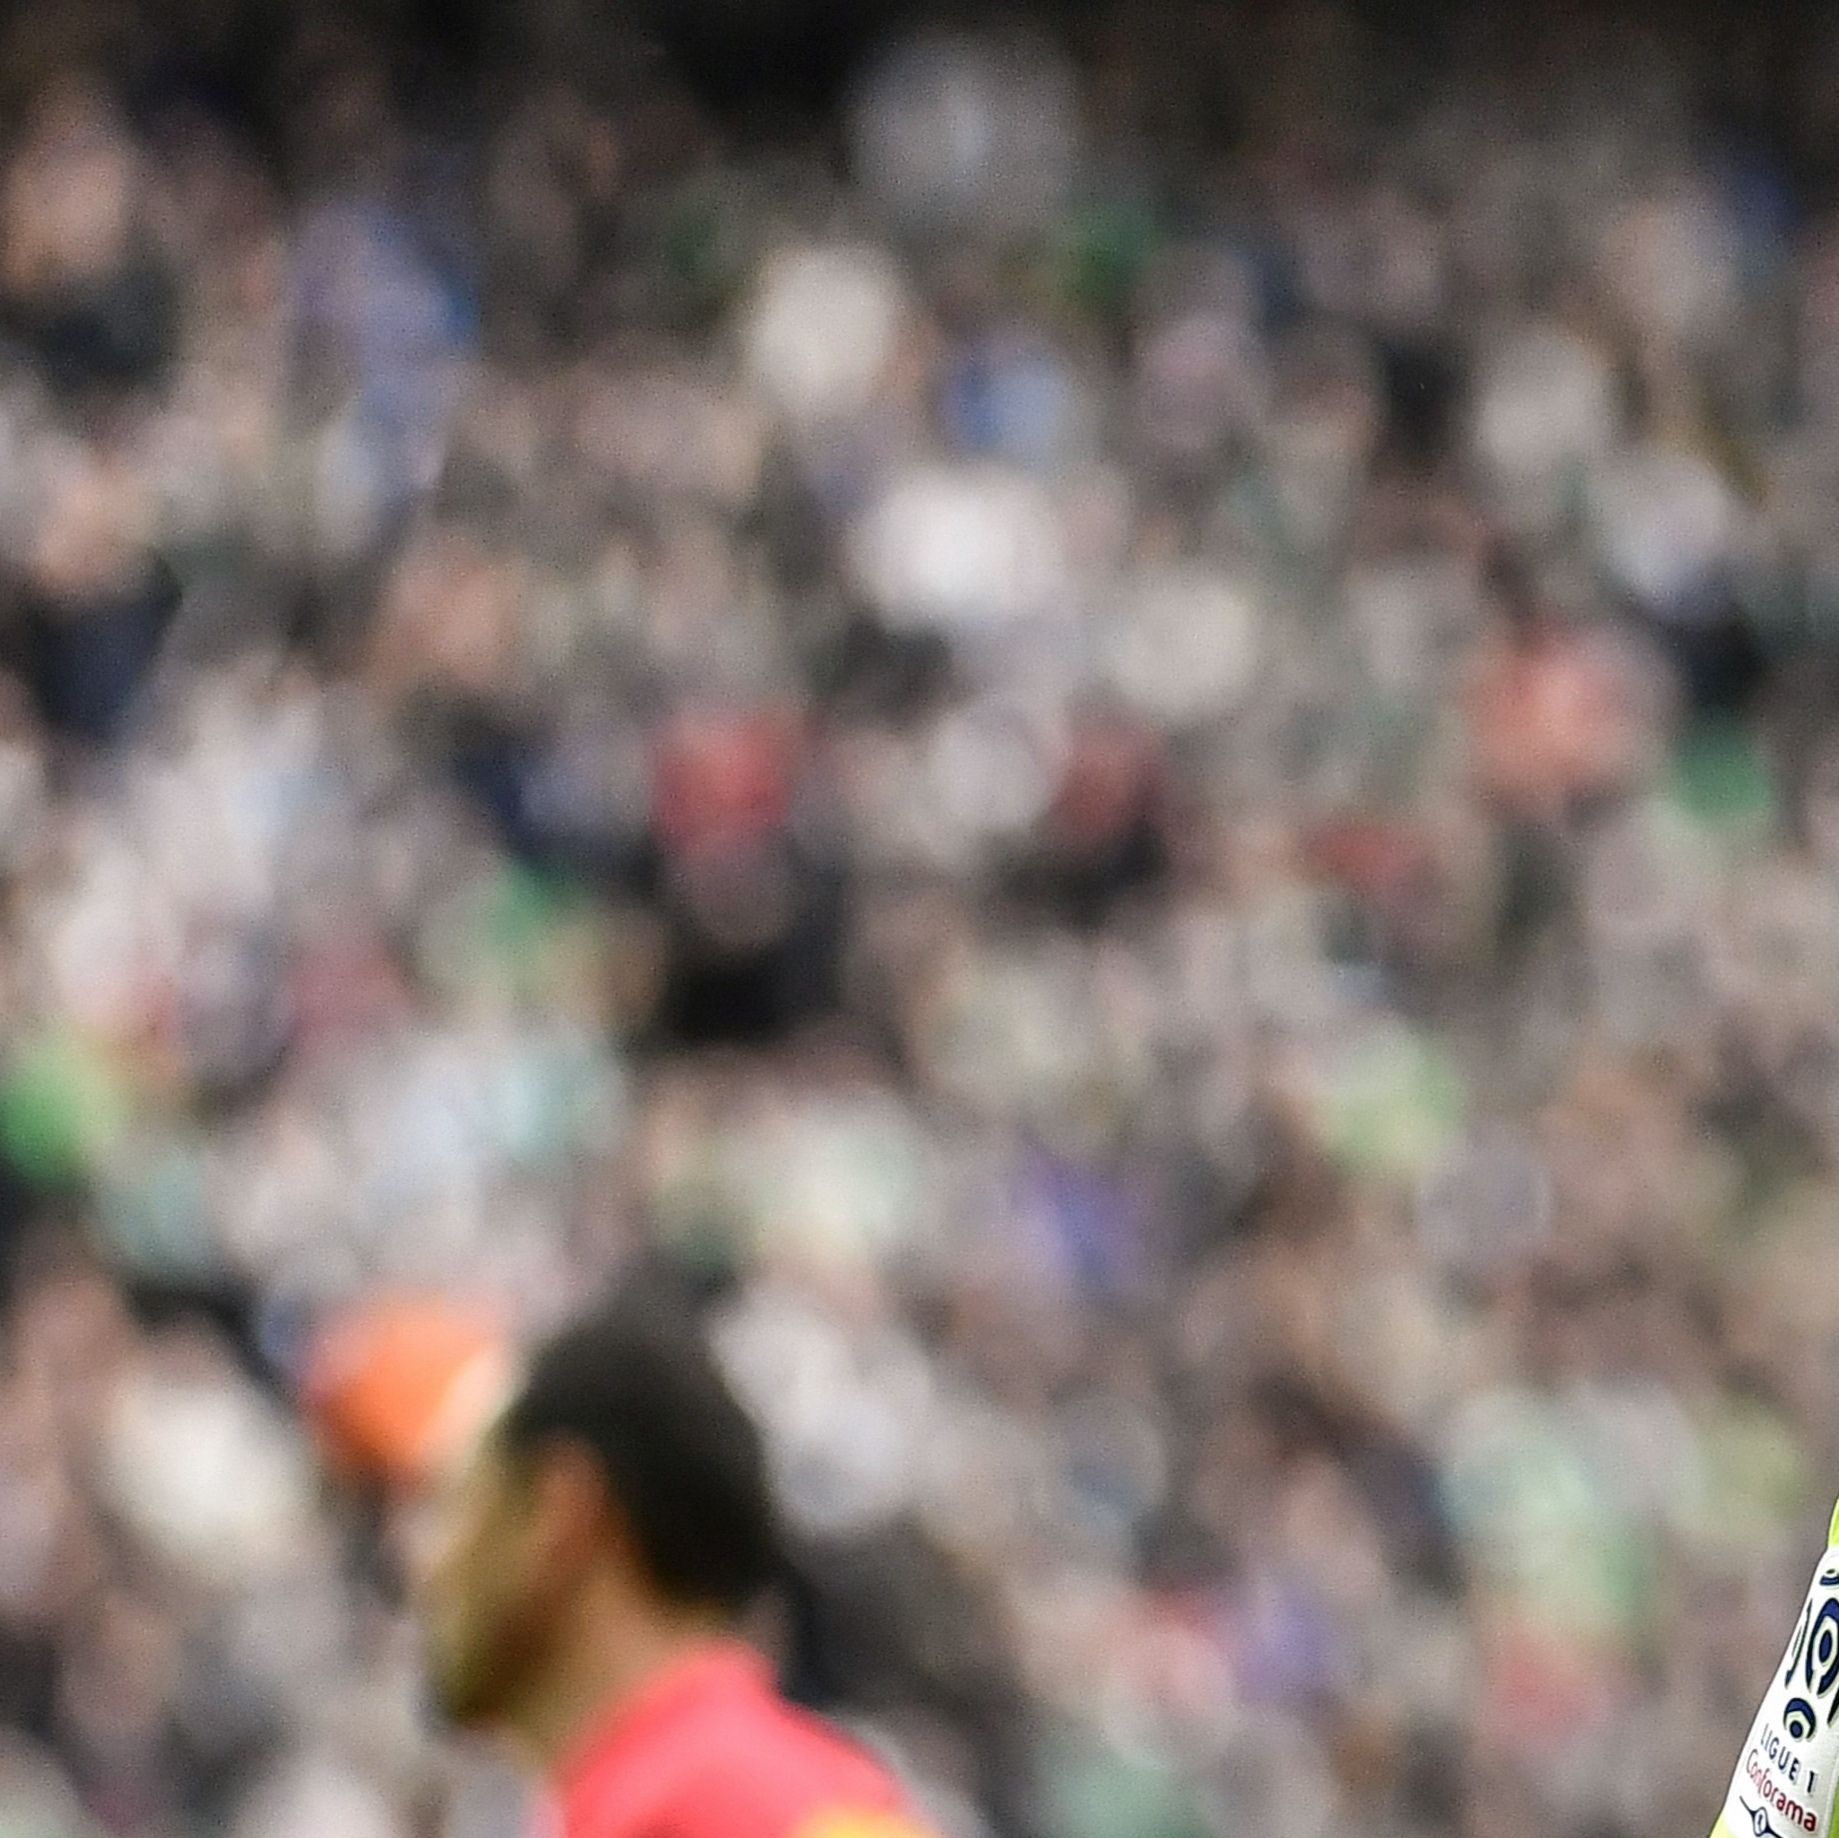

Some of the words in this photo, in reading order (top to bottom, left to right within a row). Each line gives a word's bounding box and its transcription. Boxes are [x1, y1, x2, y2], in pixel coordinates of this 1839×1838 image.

[1746, 1748, 1818, 1832] Conforama
[1761, 1723, 1799, 1781] LIGUE
[1807, 1770, 1815, 1793] 1
